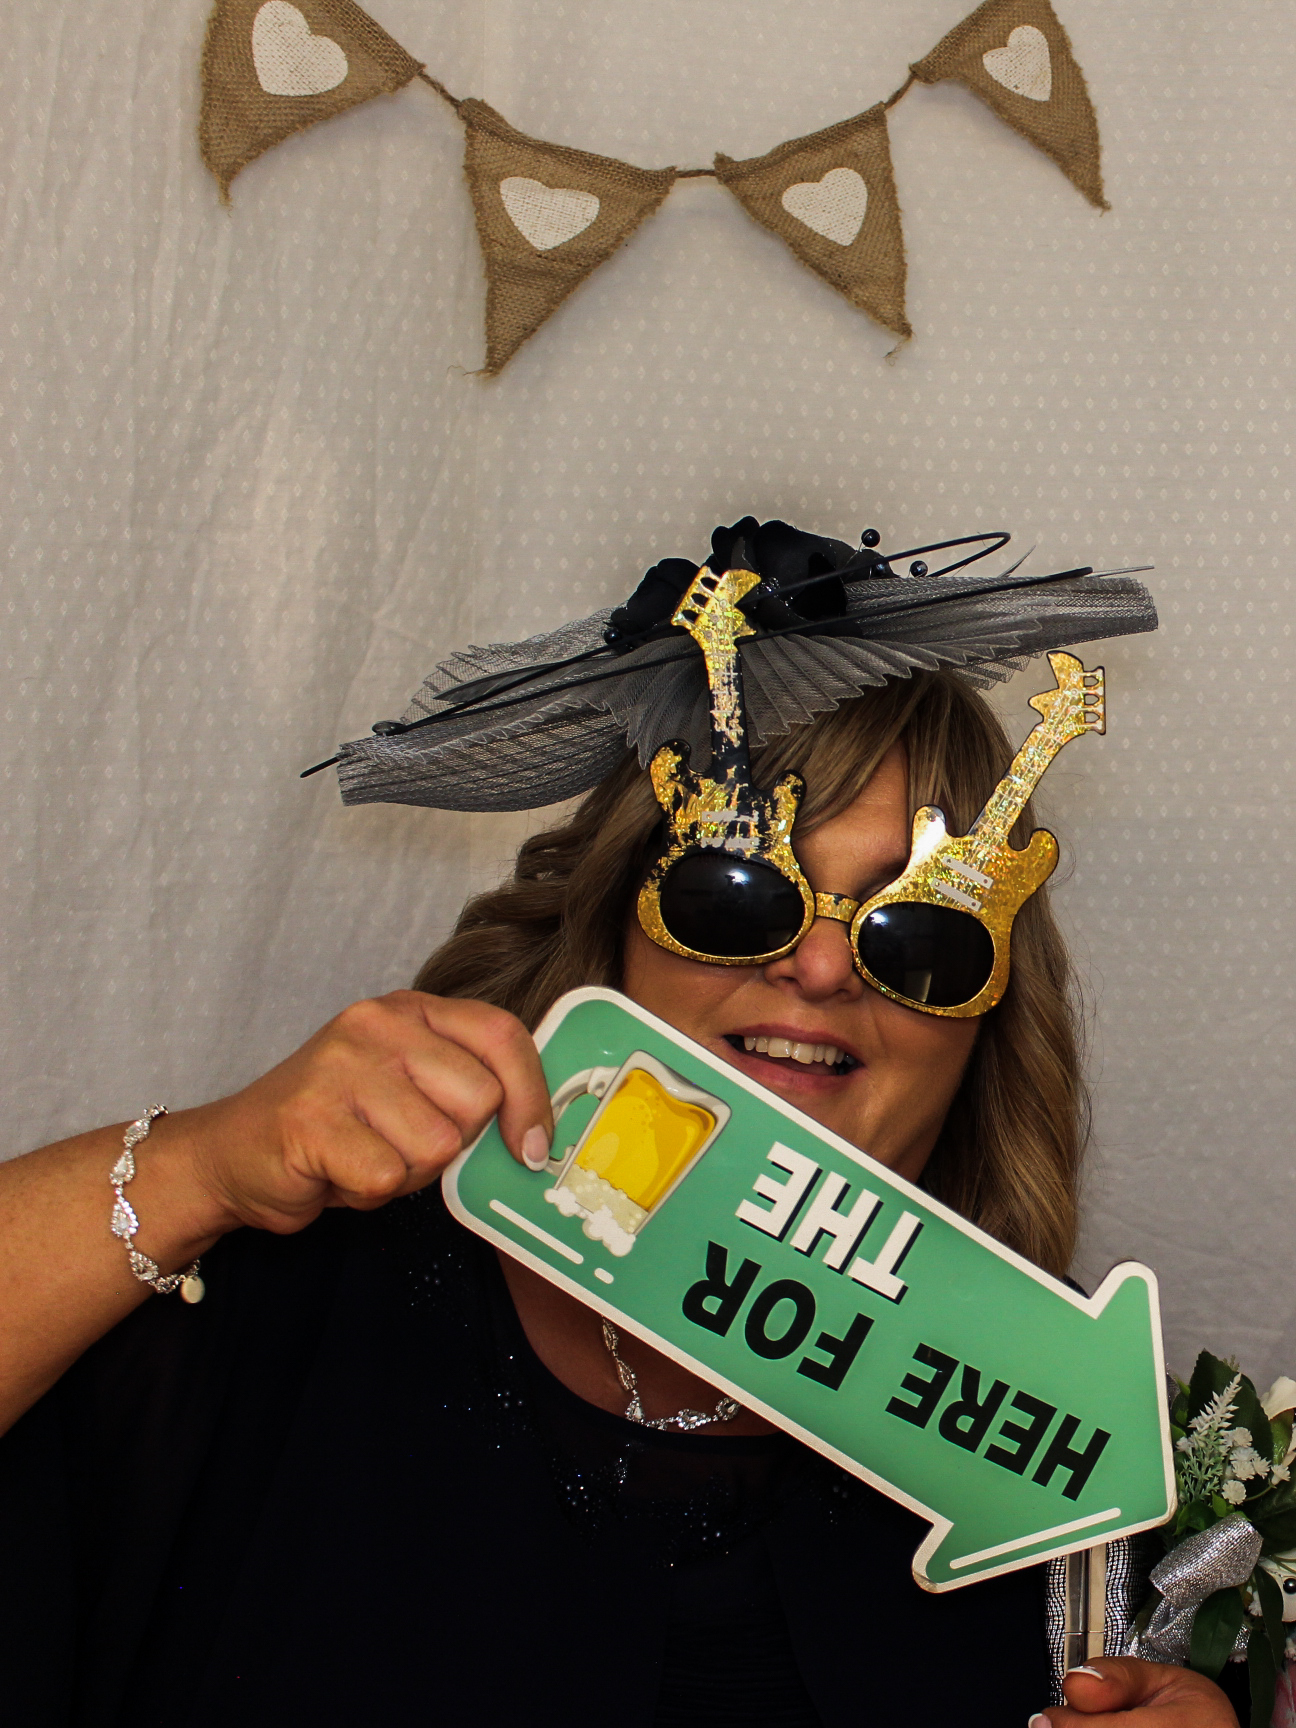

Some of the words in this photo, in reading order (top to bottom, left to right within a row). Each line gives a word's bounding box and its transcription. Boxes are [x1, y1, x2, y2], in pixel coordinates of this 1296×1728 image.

[734, 1140, 924, 1304] THE
[681, 1240, 875, 1391] FOR
[884, 1342, 1112, 1501] HERE
